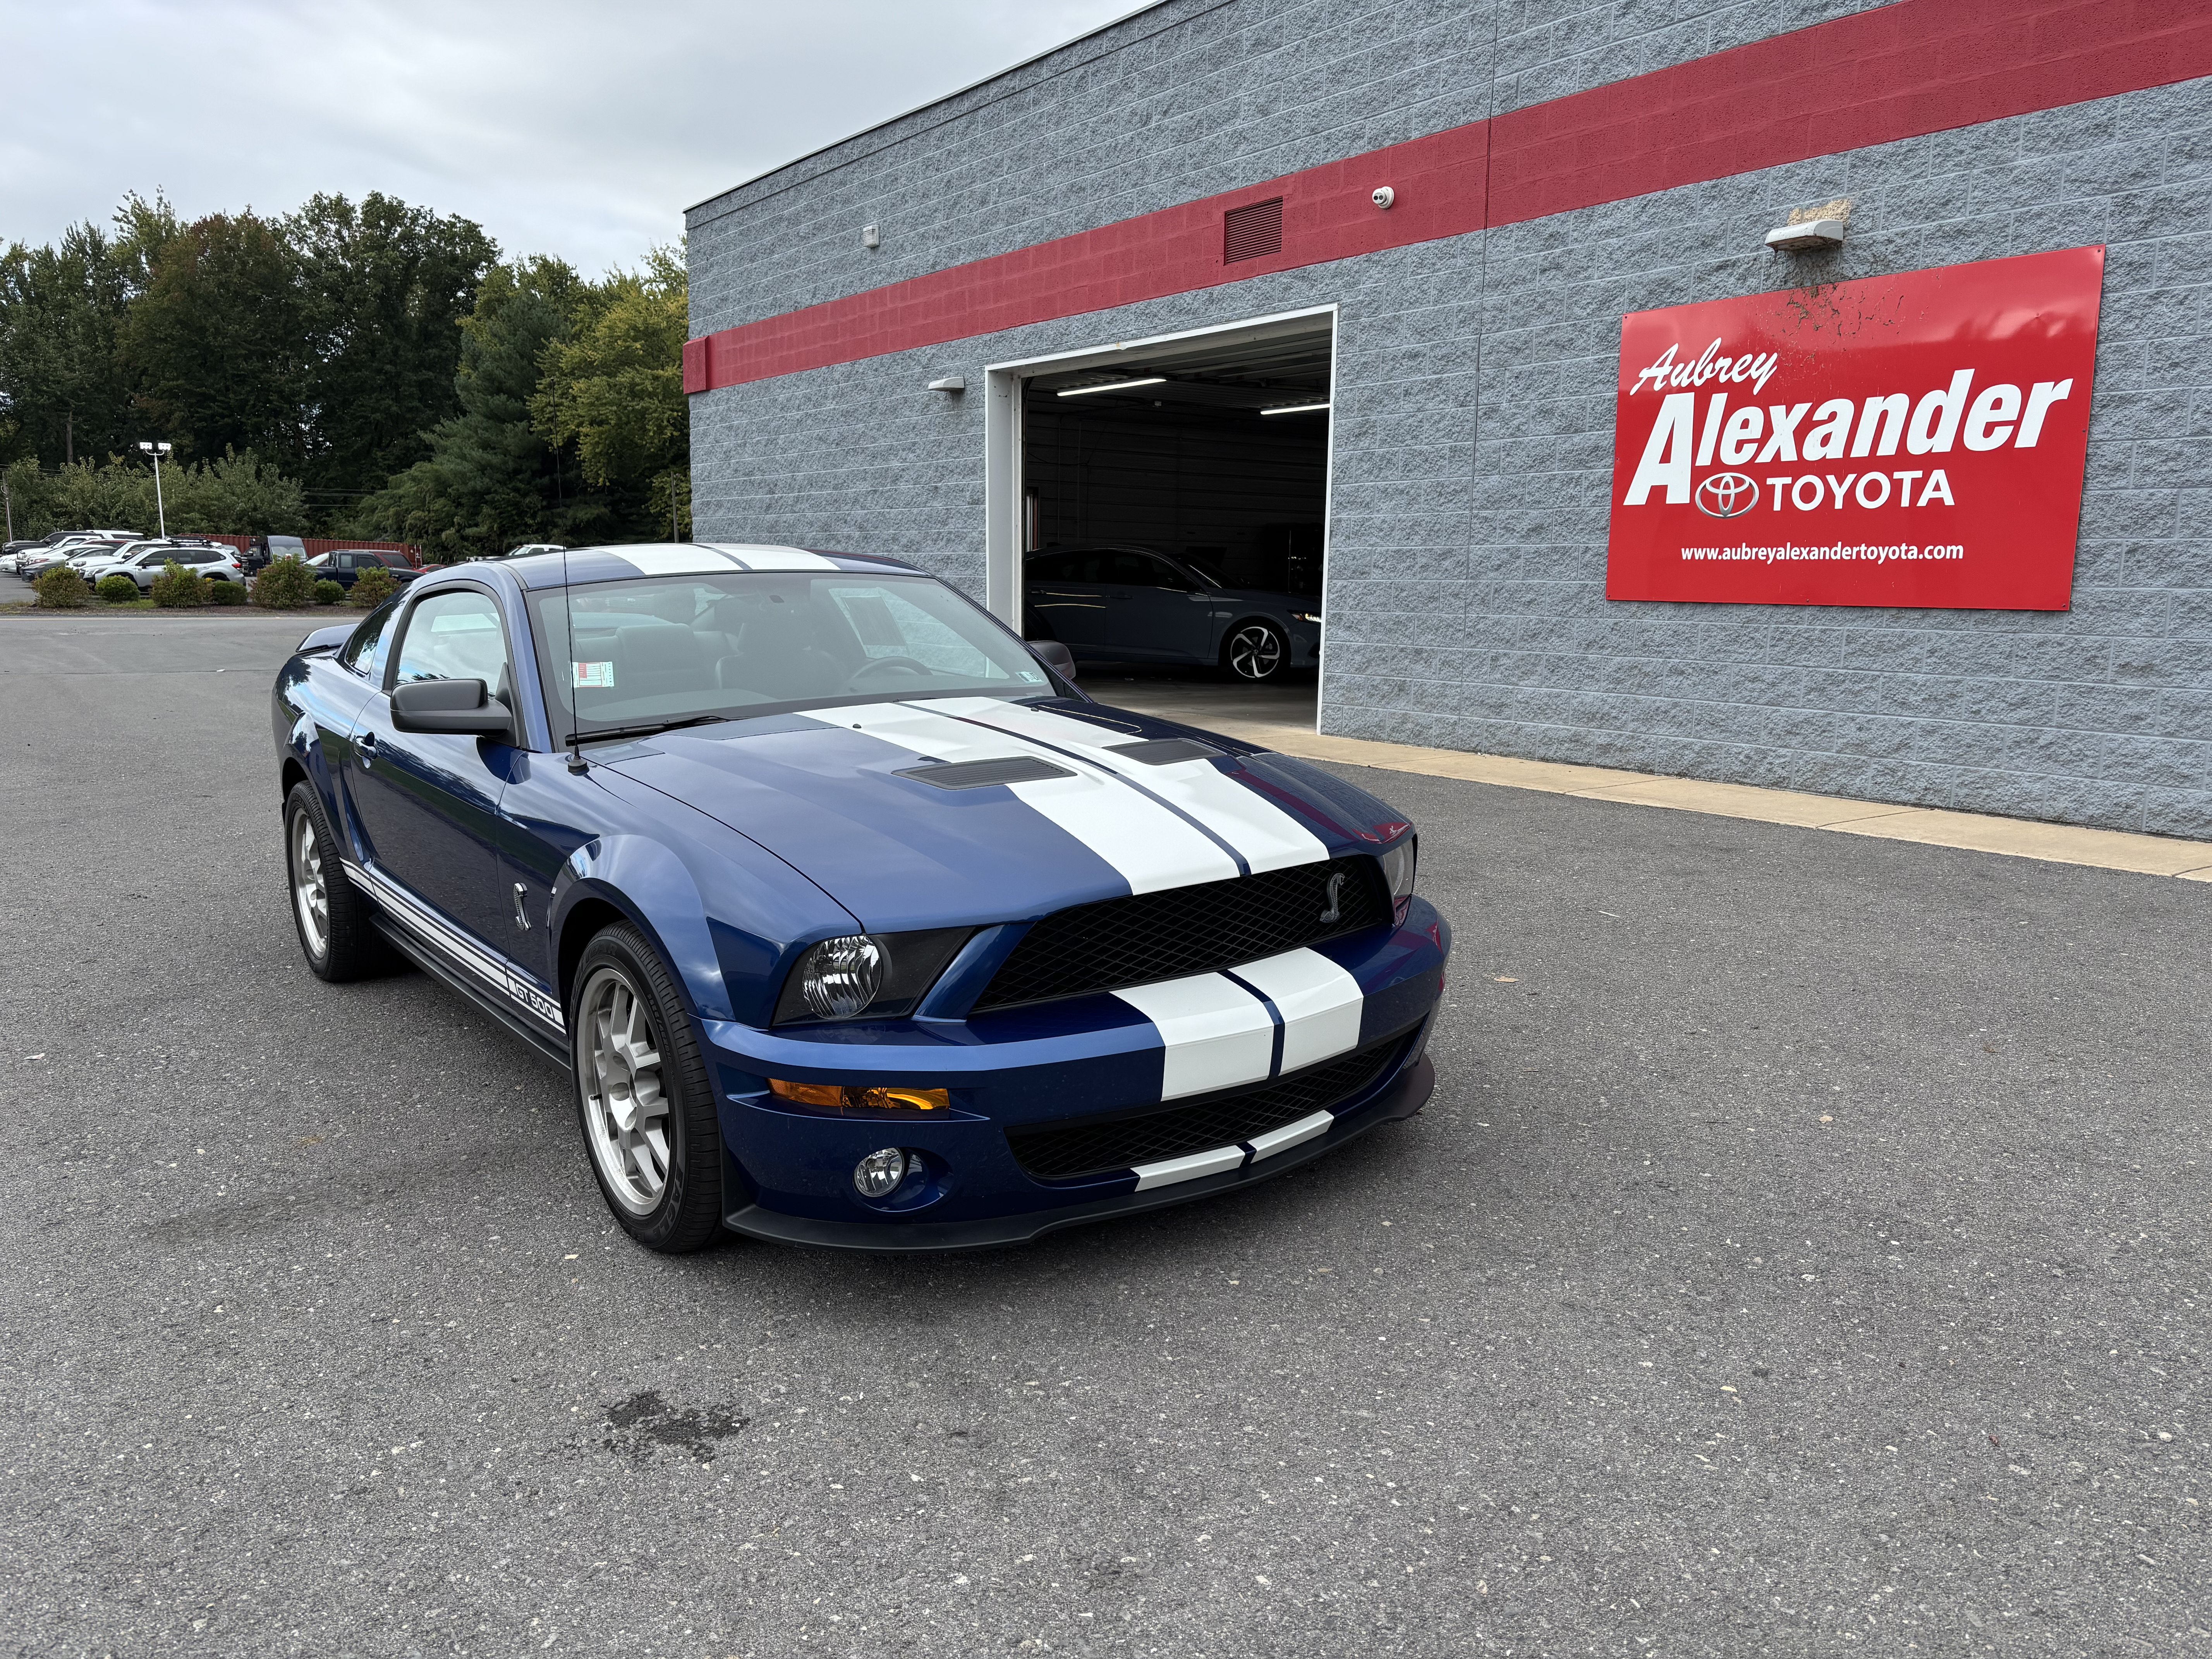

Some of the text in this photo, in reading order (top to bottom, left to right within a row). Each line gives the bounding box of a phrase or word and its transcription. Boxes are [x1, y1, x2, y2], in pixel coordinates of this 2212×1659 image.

[1630, 337, 1778, 395] Aubrey
[1623, 369, 2074, 506] Alexander
[1766, 469, 1955, 511] TOYOTA
[1681, 542, 1964, 565] www.aubreyalexandertoyota.com
[516, 983, 554, 1019] GT 500
